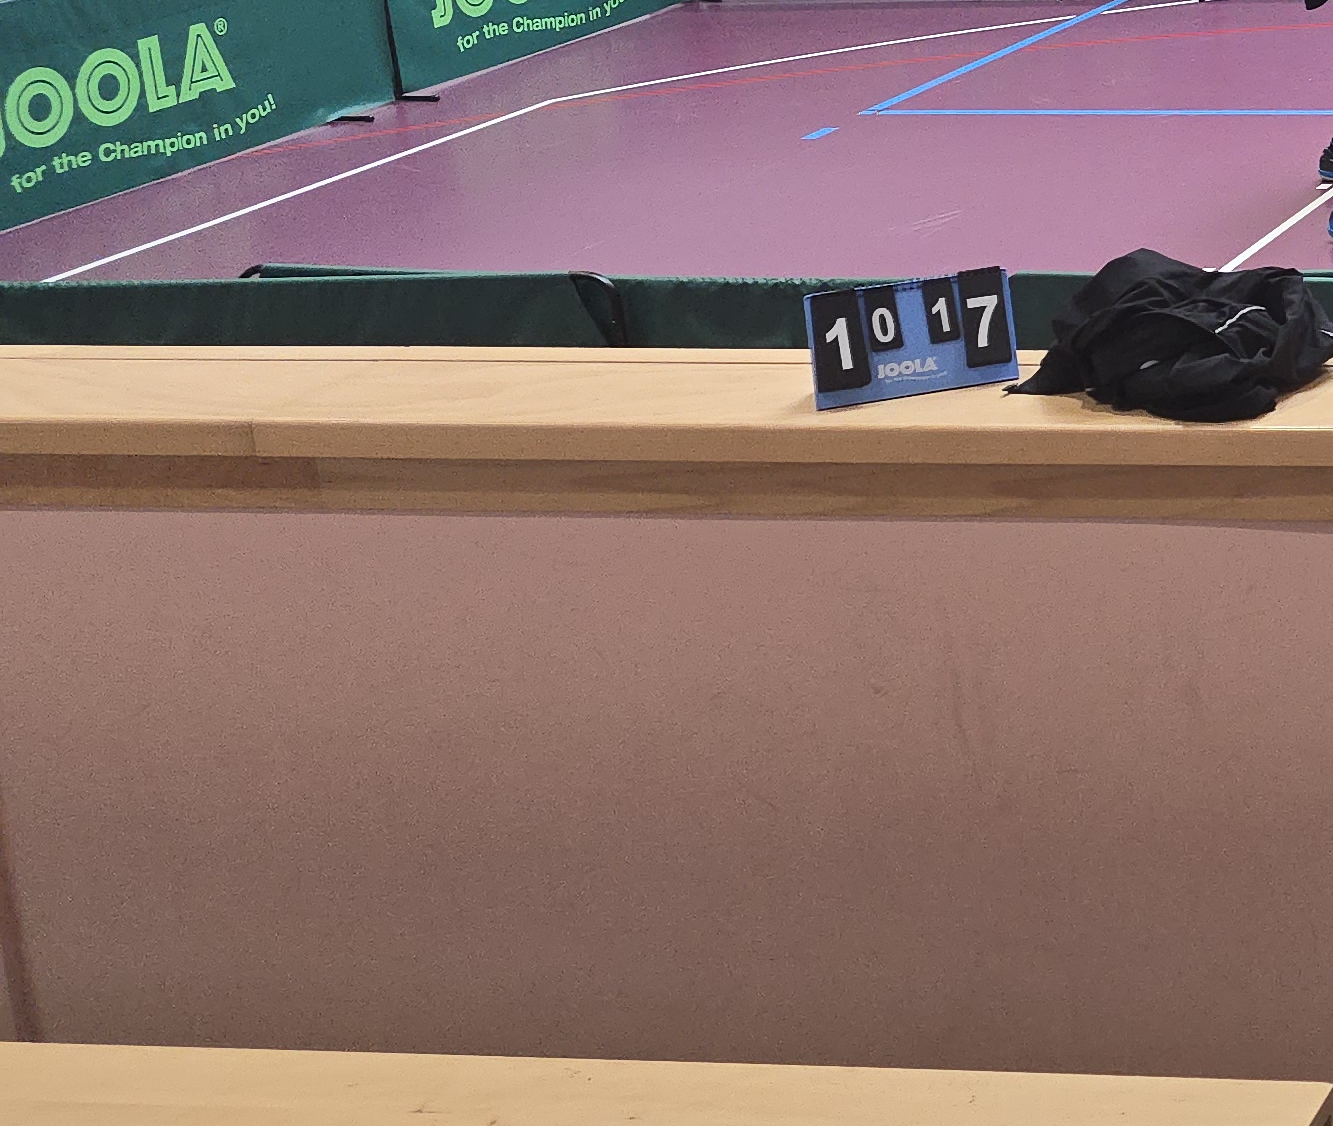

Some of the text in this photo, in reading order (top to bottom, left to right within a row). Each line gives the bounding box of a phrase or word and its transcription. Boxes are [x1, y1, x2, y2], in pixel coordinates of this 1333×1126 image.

[456, 31, 480, 53] for
[483, 21, 509, 40] the
[512, 11, 586, 34] Champion
[588, 6, 601, 22] in
[0, 22, 237, 158] OOLA
[11, 93, 278, 194] for the Champion in you!
[825, 294, 998, 371] 1 0 1 7
[877, 357, 939, 380] JOOLA
